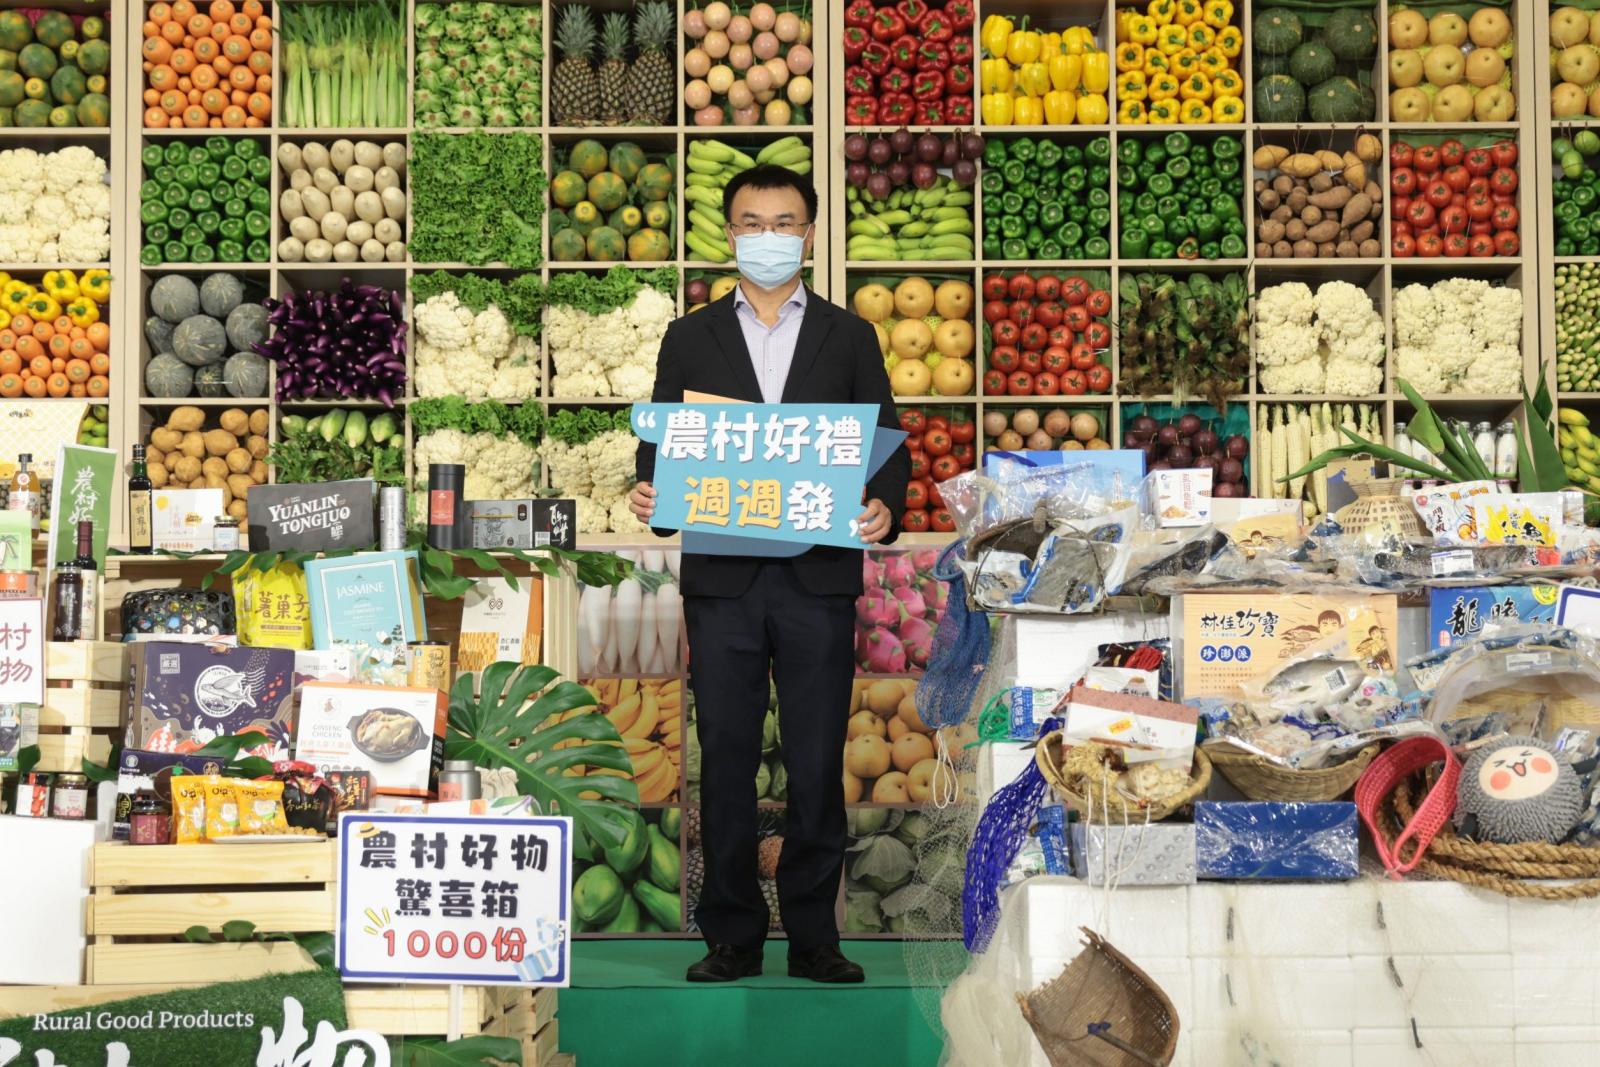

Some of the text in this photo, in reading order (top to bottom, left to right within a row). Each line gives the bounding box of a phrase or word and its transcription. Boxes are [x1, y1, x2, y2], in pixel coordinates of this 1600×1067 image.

[68, 466, 99, 545] 農村好
[268, 494, 340, 522] YUANLIN
[280, 506, 351, 534] TONGLUO
[336, 582, 385, 600] JASMINE
[0, 621, 32, 651] 村
[0, 655, 33, 685] 物
[360, 831, 549, 872] 農村好物
[395, 878, 519, 918] 驚喜箱
[383, 926, 527, 963] 1000份
[33, 1010, 255, 1031] Rural Good Products
